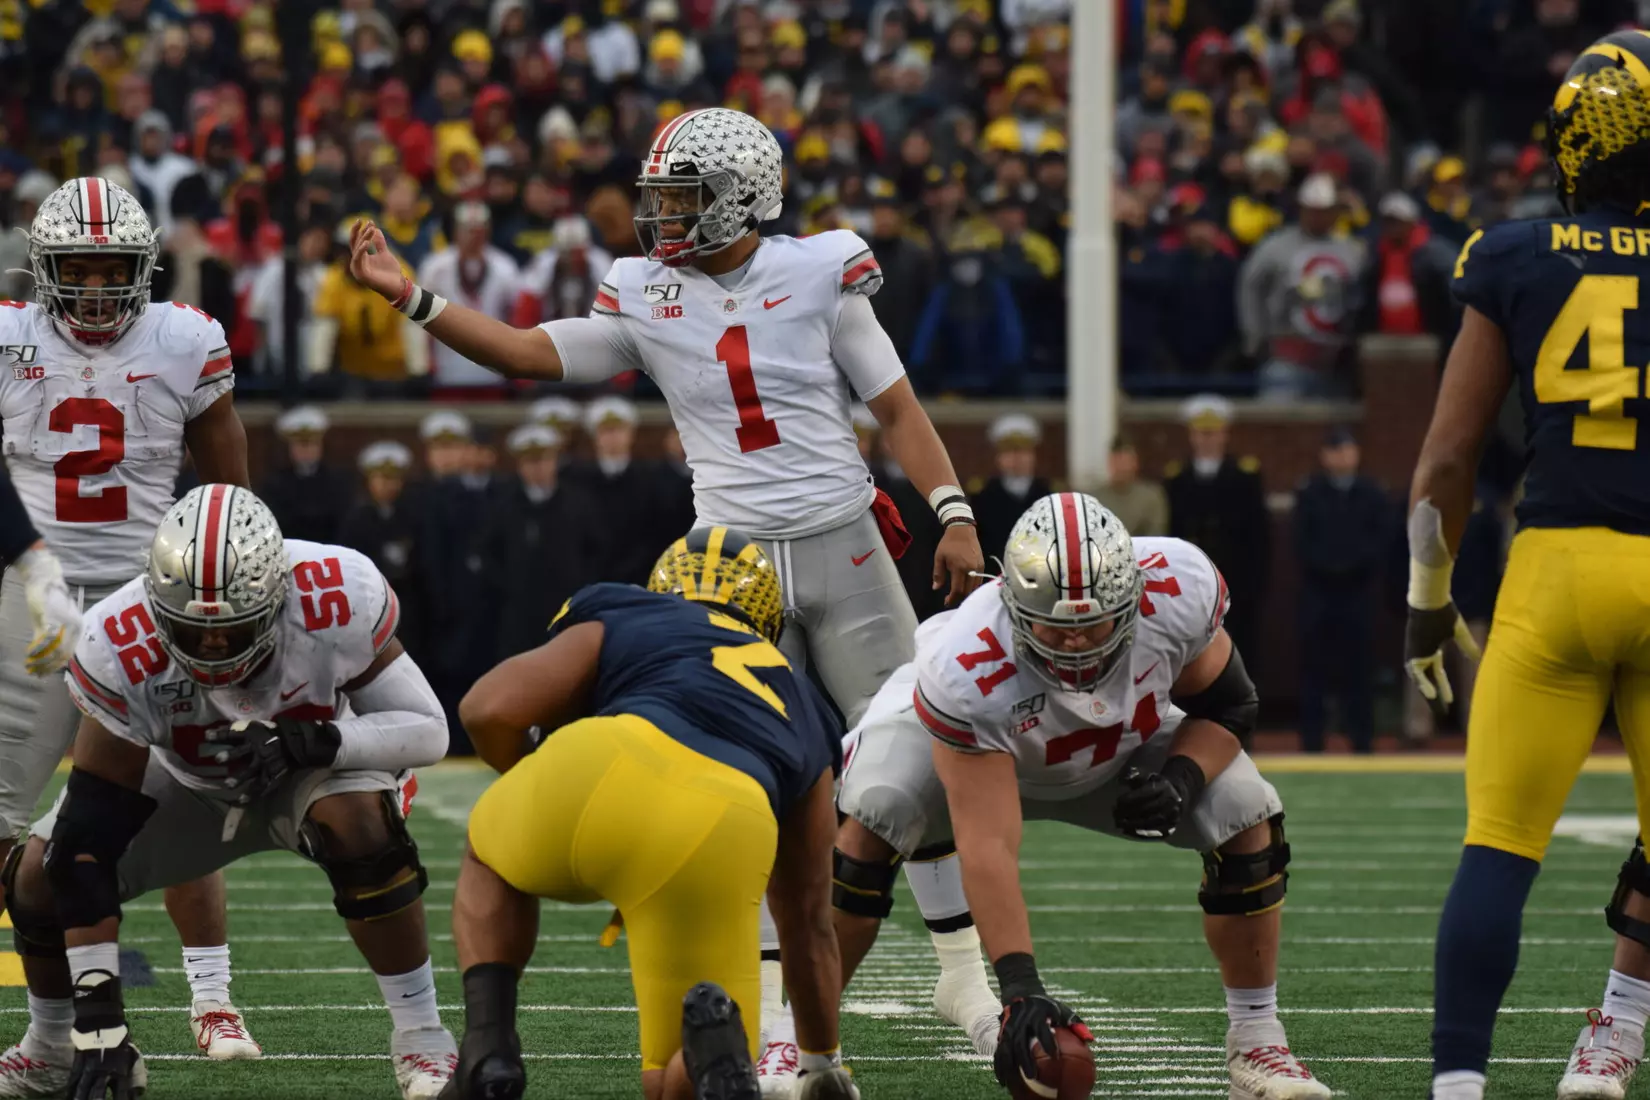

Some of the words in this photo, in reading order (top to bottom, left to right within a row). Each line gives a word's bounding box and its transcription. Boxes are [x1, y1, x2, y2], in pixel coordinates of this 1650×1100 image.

[715, 325, 781, 454] 1
[1533, 274, 1650, 451] 4
[49, 397, 128, 522] 2
[103, 602, 170, 686] 52
[294, 556, 352, 631] 52
[956, 626, 1019, 697] 71
